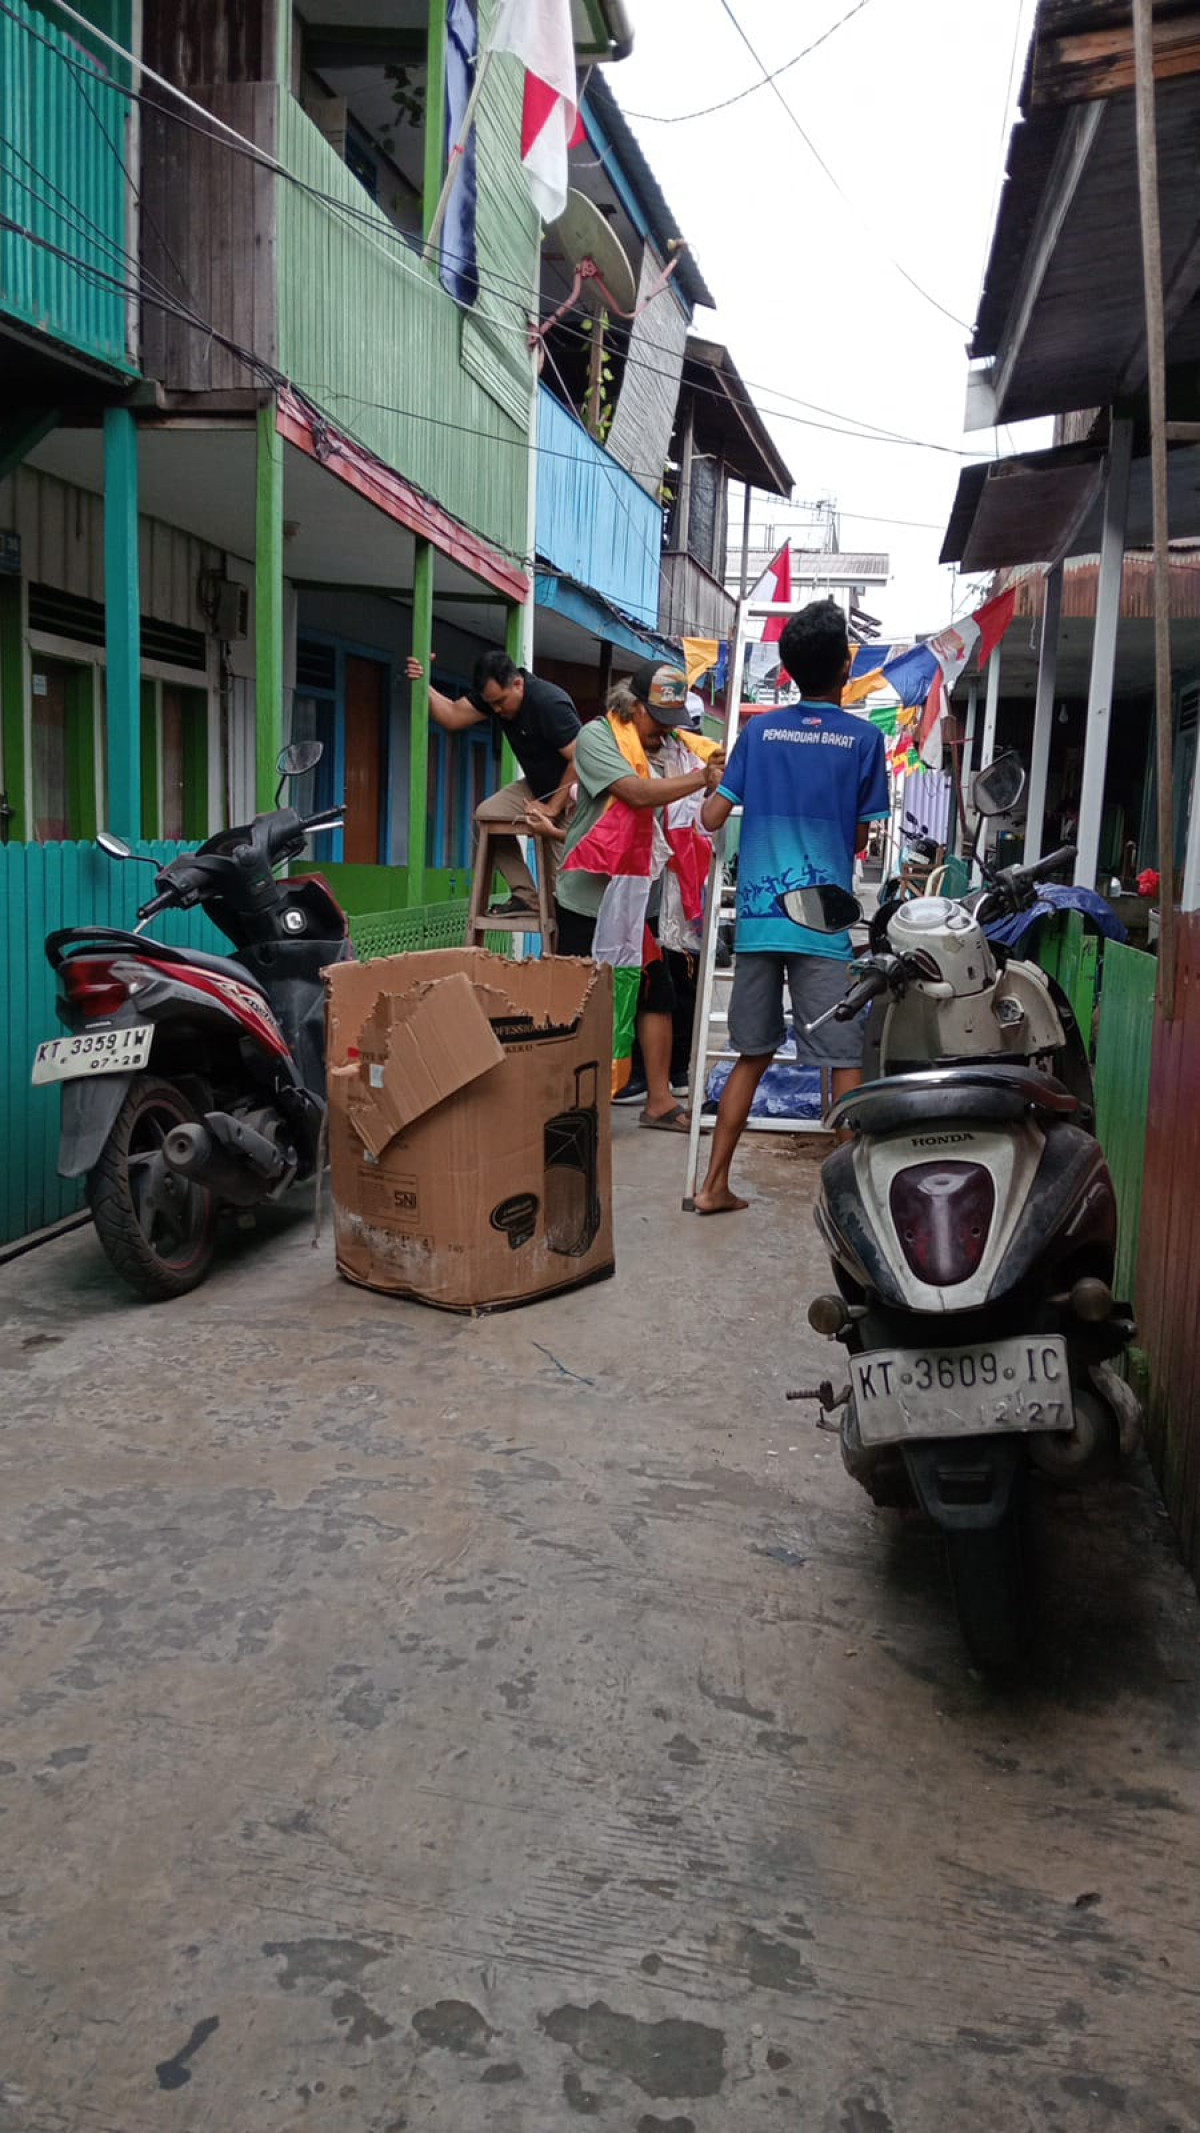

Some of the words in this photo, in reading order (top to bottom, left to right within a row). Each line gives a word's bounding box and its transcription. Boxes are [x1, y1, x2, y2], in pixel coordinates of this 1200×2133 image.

[763, 728, 820, 745] PEMANDUAN
[821, 731, 855, 749] BAKAT
[37, 1041, 62, 1062] KT
[71, 1033, 117, 1055] 3359
[123, 1029, 147, 1048] IW
[911, 1132, 976, 1147] HONDA
[859, 1361, 893, 1400] KT
[915, 1352, 997, 1390] 3609
[1027, 1348, 1060, 1383] IC
